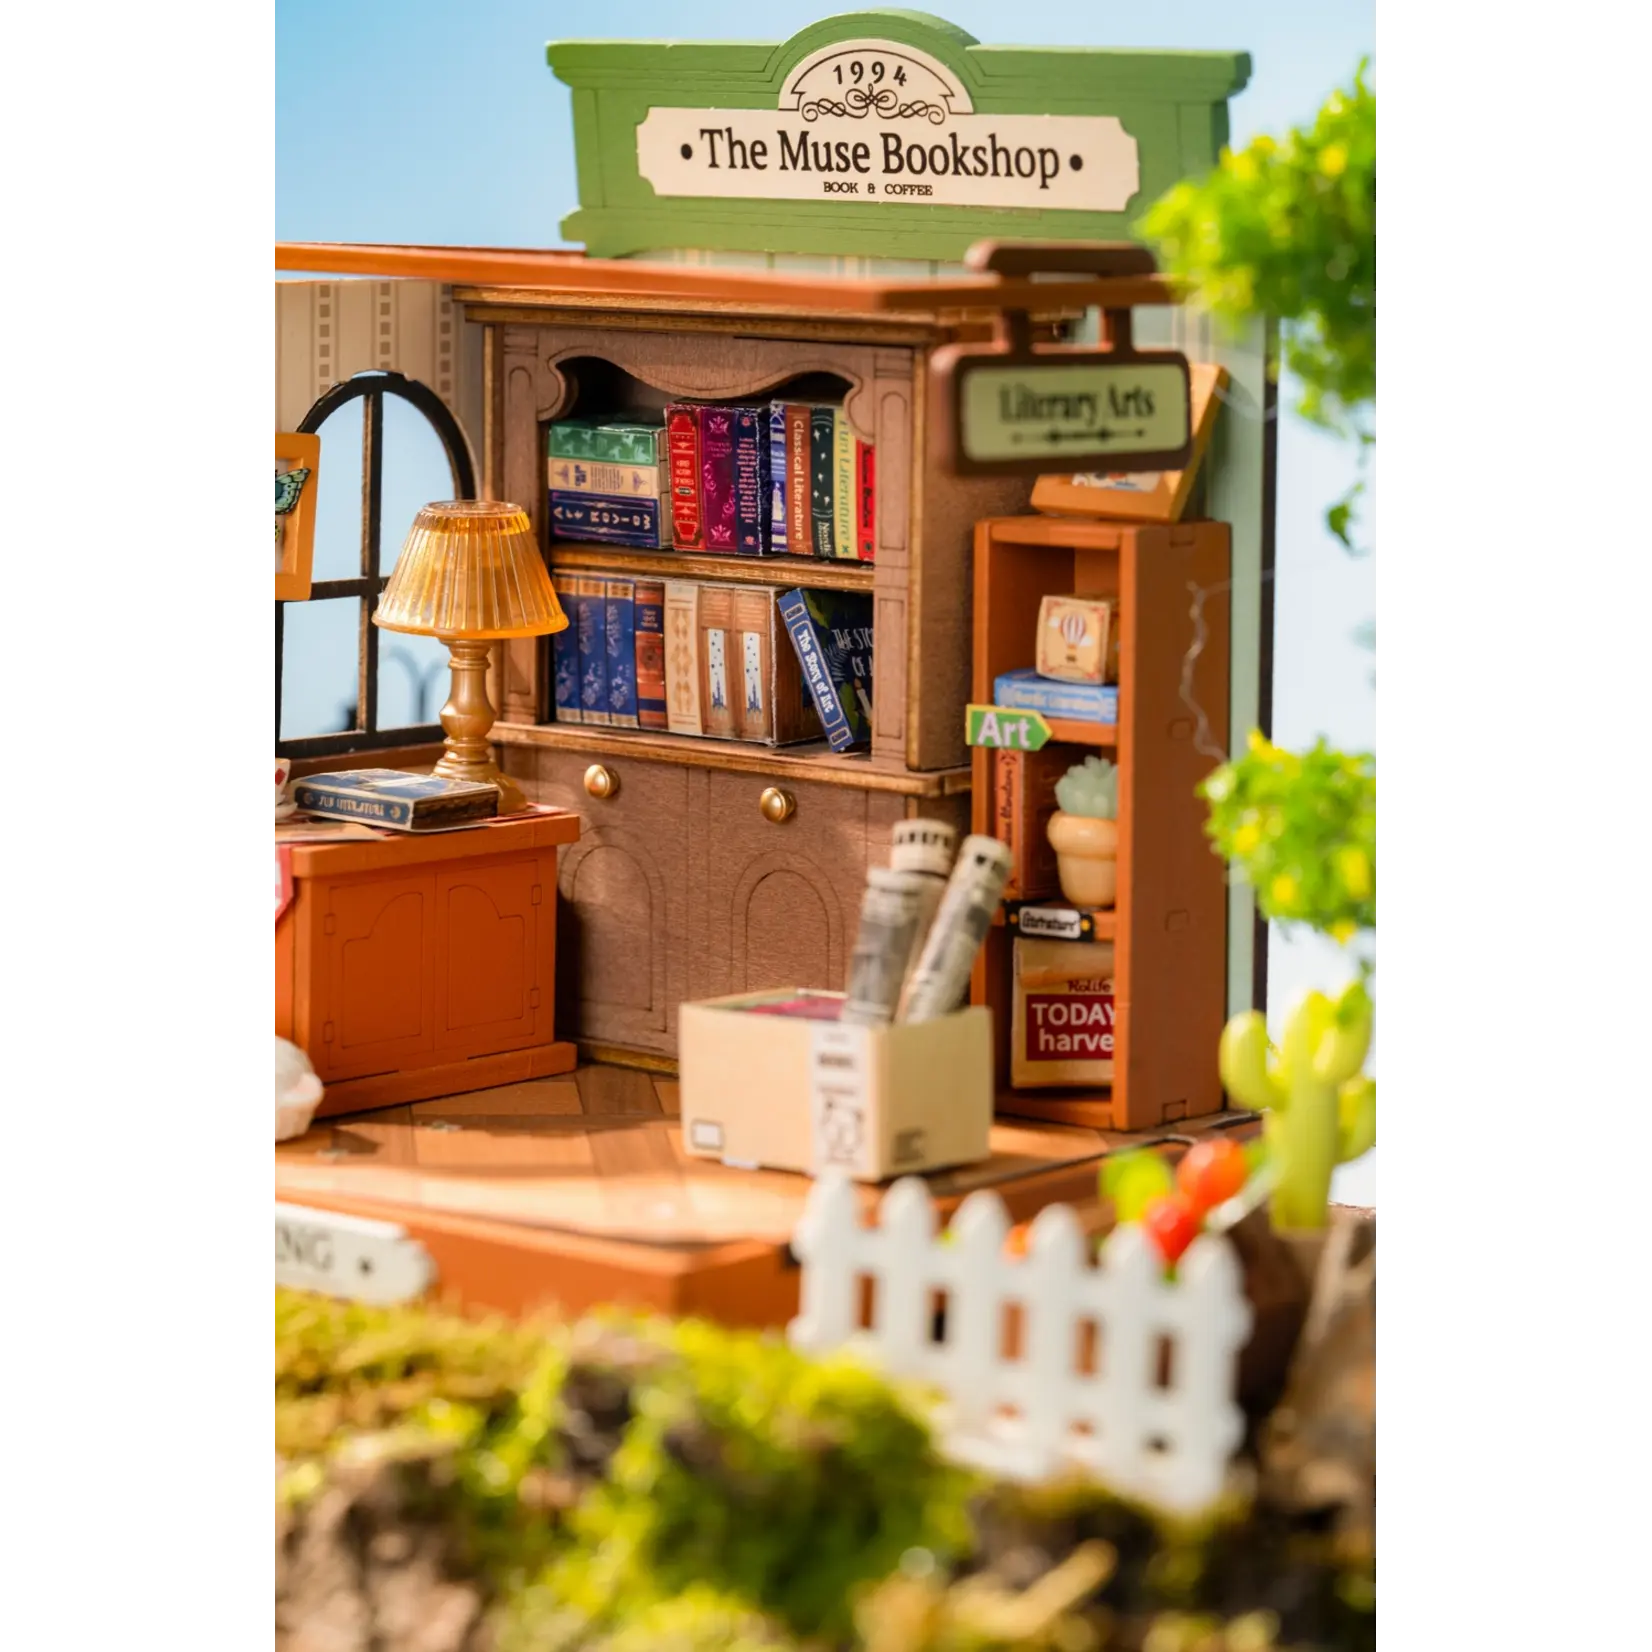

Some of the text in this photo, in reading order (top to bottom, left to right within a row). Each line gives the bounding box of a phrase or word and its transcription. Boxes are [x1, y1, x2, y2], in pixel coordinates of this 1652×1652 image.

[832, 60, 907, 87] 1994
[699, 126, 1060, 190] The Muse Bookshop
[823, 181, 933, 196] BOOK & COFFEE
[1000, 382, 1155, 426] Literary Arts
[793, 419, 805, 541] Classical Literature
[797, 629, 811, 652] The
[977, 713, 1031, 748] Art
